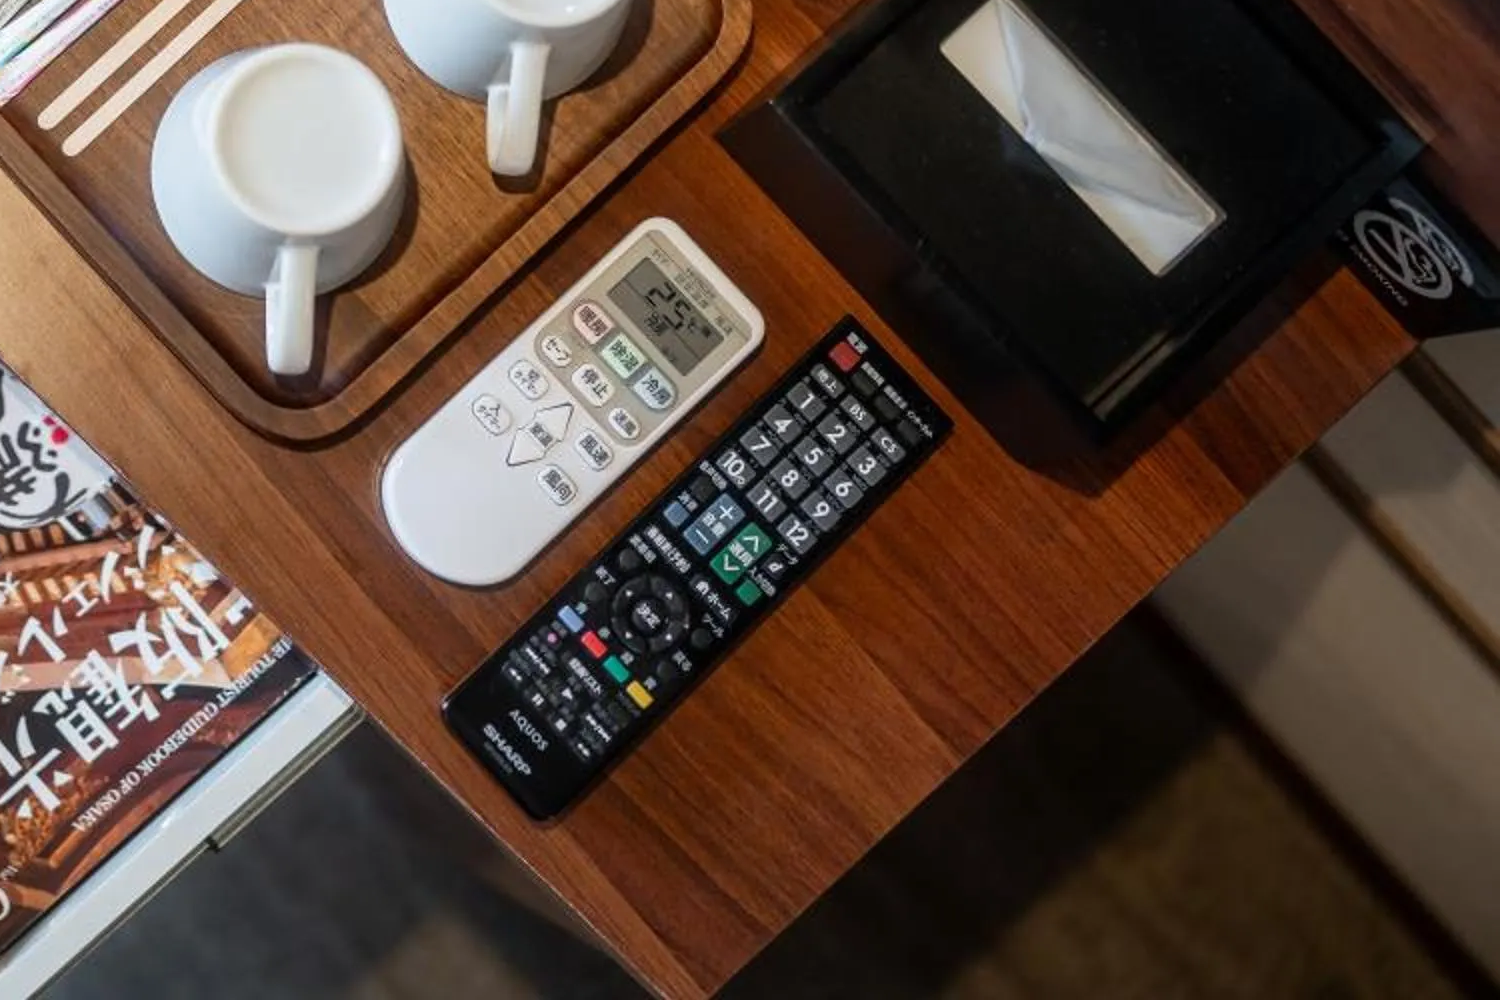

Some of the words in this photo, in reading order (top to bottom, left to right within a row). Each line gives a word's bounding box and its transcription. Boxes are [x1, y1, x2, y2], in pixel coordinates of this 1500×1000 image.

[643, 279, 692, 330] 25
[578, 365, 612, 400] 停止
[640, 373, 672, 406] 冷房
[488, 401, 504, 417] 入
[797, 392, 815, 410] 1
[847, 402, 867, 422] BS
[772, 415, 794, 435] 4
[825, 423, 847, 445] 2
[749, 434, 772, 454] 7
[802, 445, 825, 466] 5
[877, 434, 898, 455] CS
[779, 467, 801, 489] 8
[856, 455, 878, 476] 3
[542, 468, 574, 501] 風向
[833, 478, 854, 499] 6
[753, 487, 779, 513] 11
[810, 500, 831, 520] 9
[782, 518, 811, 547] 12
[633, 601, 662, 630] 決定
[705, 590, 734, 621] ホーム
[699, 611, 726, 640] ツール
[212, 651, 277, 709] TOURIST
[133, 699, 220, 776] GUIDEBOOK
[506, 706, 551, 753] AQUOS
[480, 721, 534, 778] SHARP
[112, 768, 142, 795] OF
[70, 786, 121, 833] OSAKA
